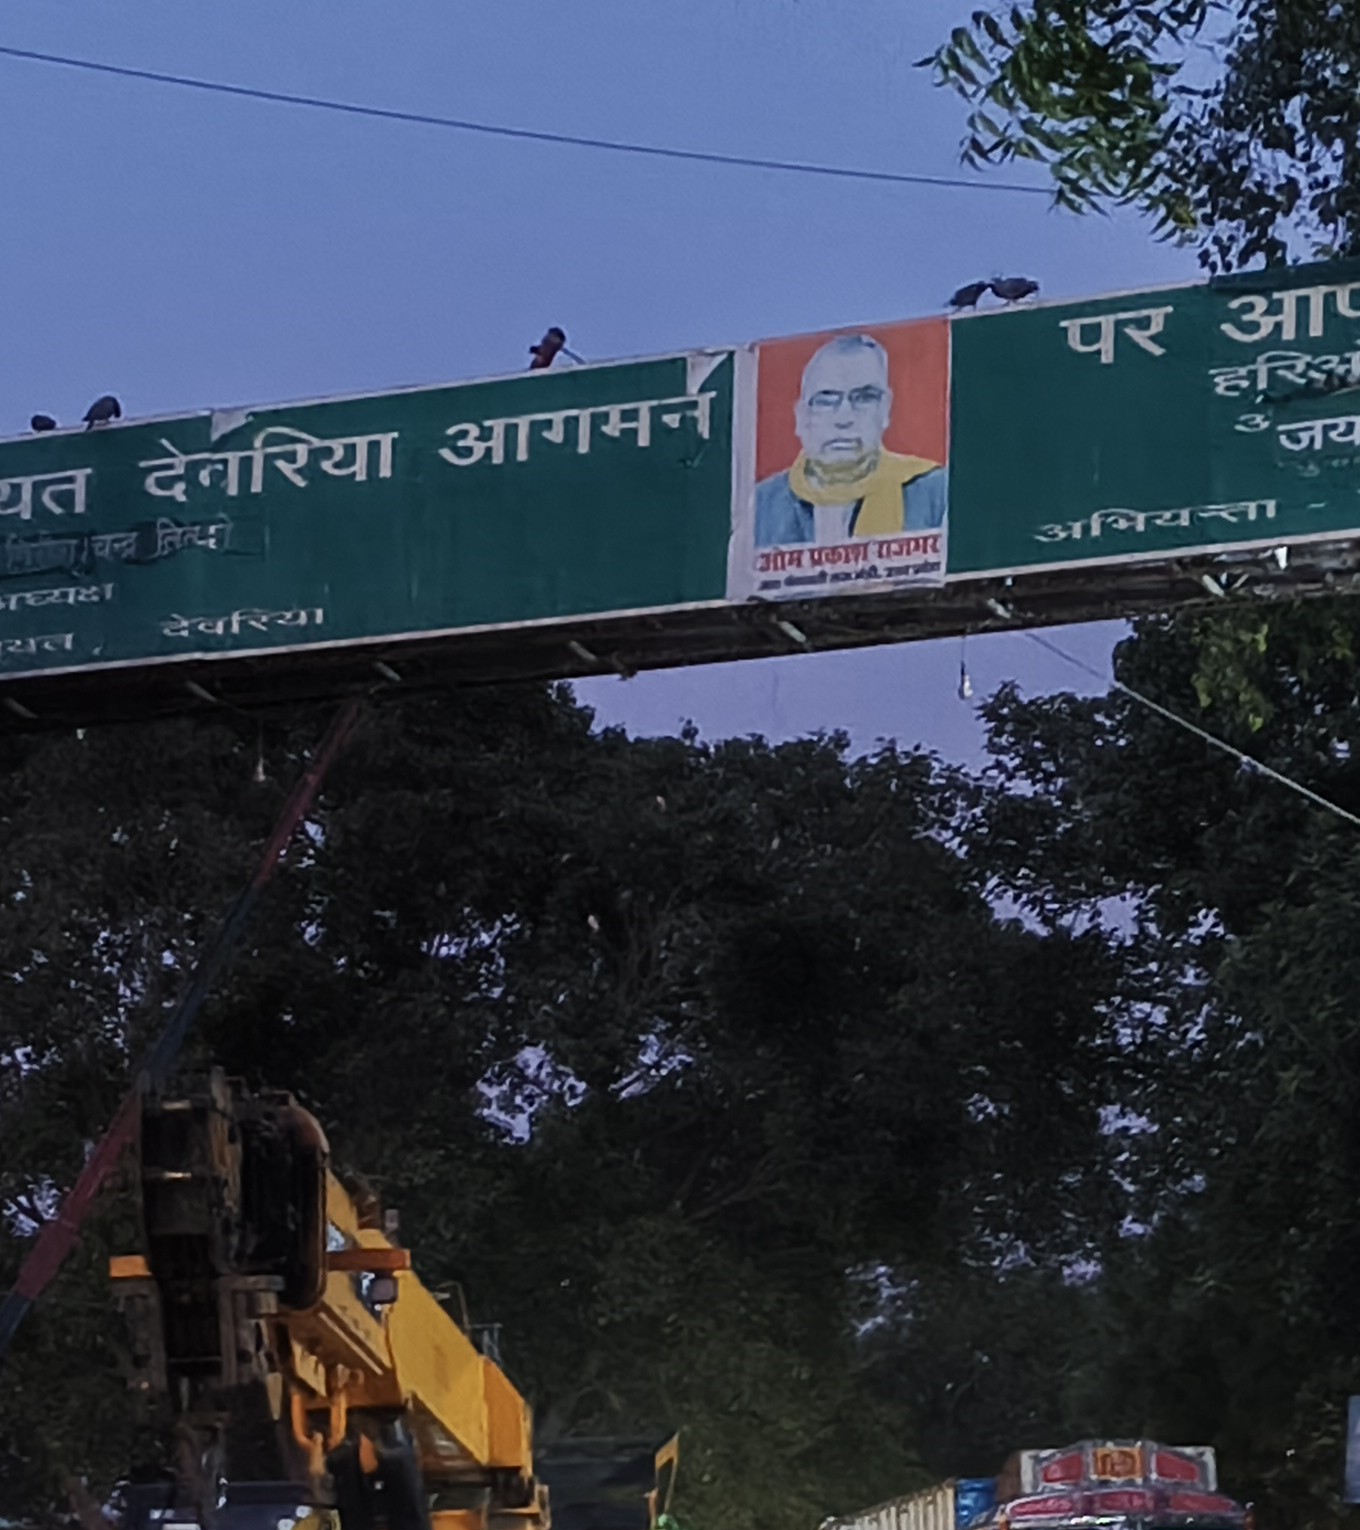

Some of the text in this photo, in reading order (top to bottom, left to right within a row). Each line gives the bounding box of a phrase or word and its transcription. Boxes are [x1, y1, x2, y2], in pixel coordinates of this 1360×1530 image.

[1059, 305, 1174, 364] पर
[138, 427, 399, 503] देवरिया
[439, 392, 718, 467] आगमन
